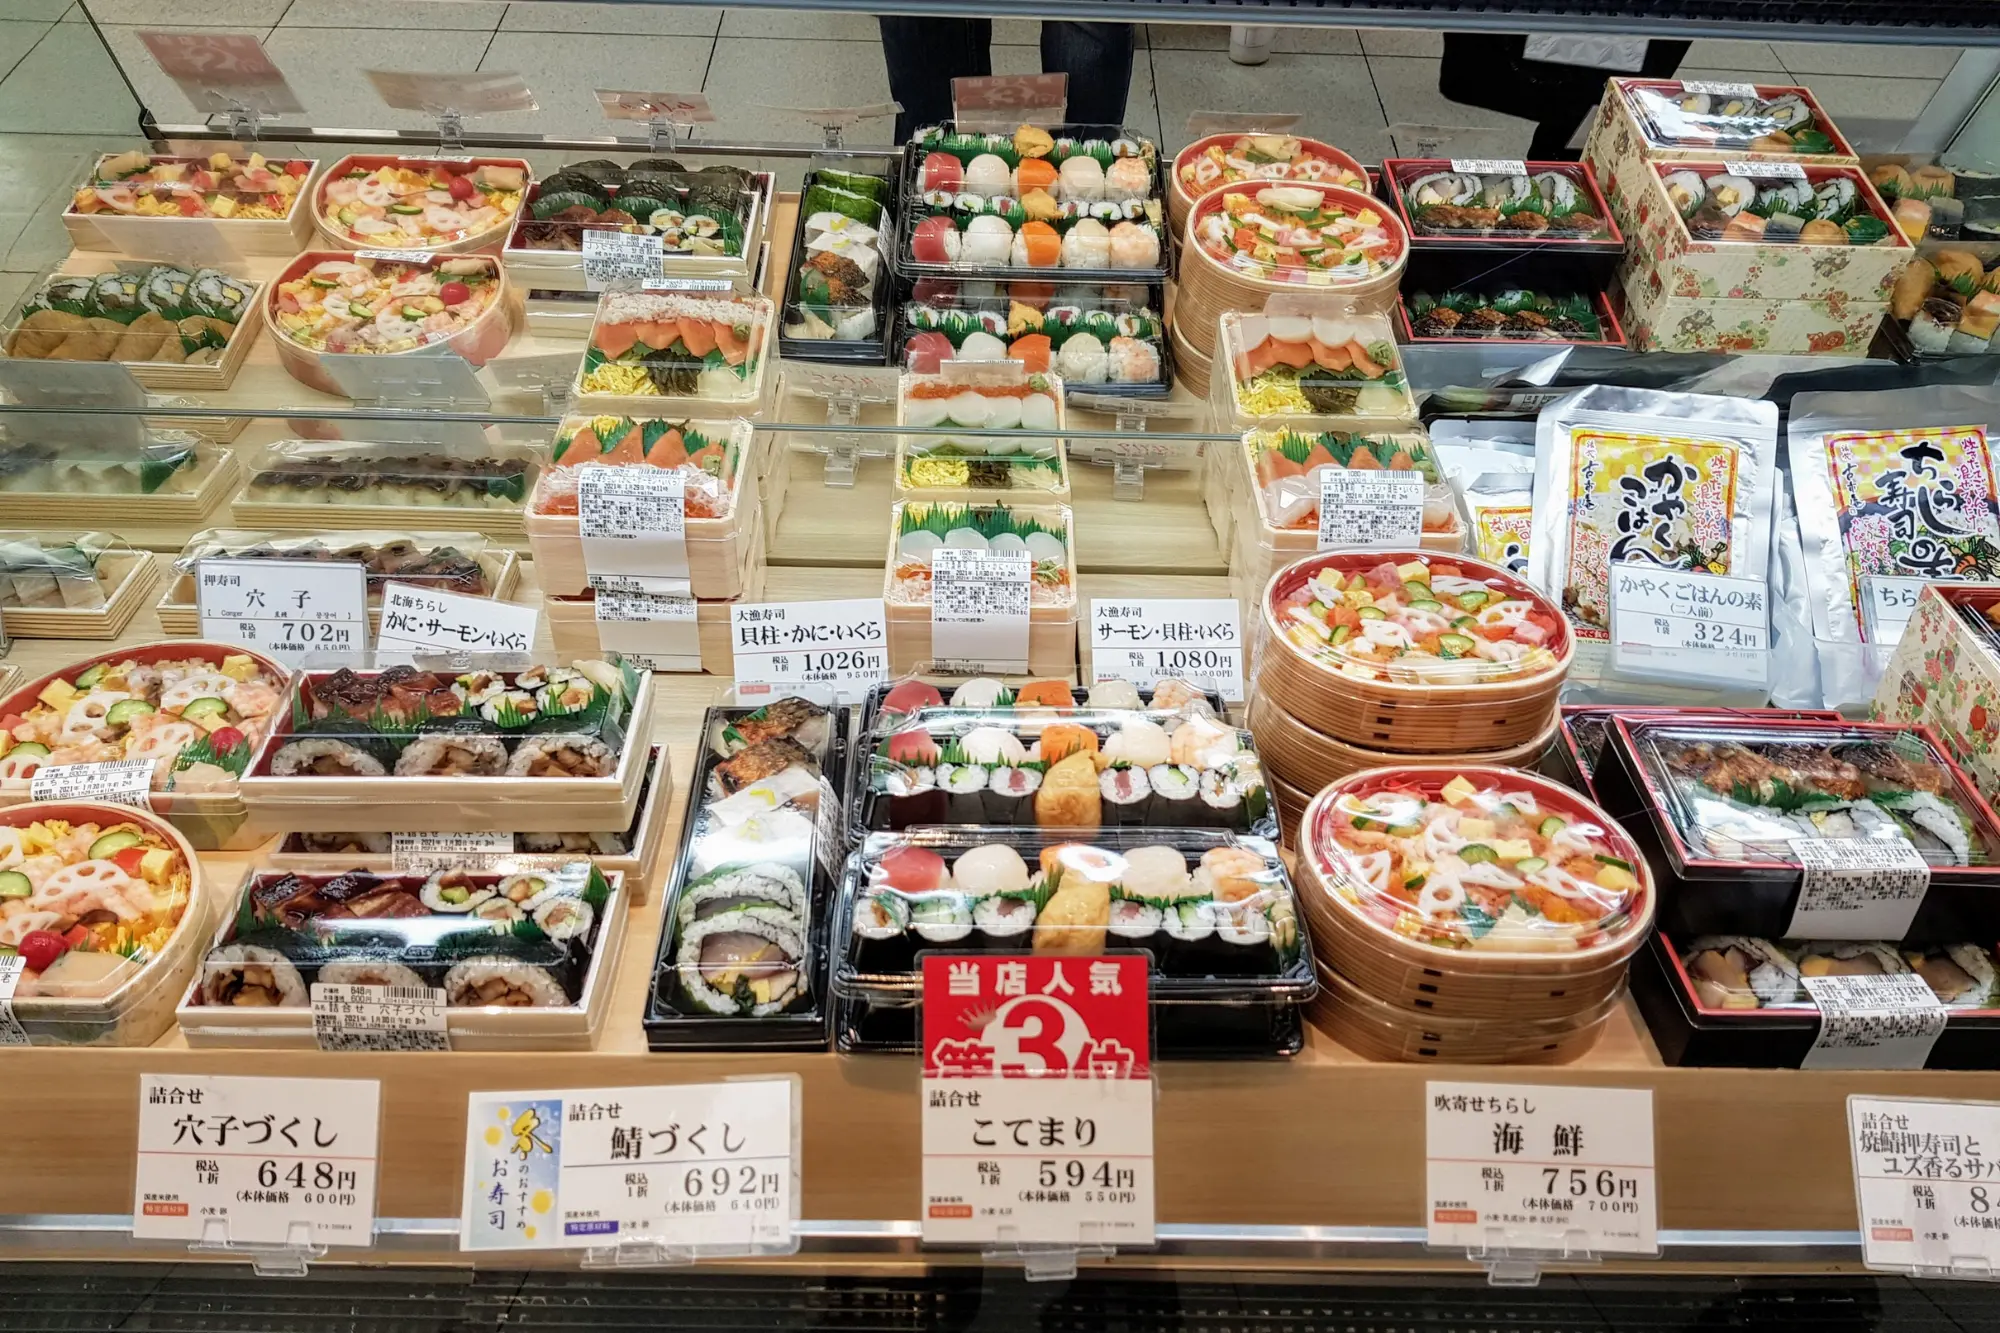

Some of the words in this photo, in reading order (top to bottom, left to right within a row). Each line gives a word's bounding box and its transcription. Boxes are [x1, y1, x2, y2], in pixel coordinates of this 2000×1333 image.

[1900, 441, 1975, 535] ちらし
[1644, 455, 1697, 549] かやく
[1609, 475, 1688, 570] ごはん
[204, 574, 240, 586] 押寿司
[246, 589, 311, 609] 穴子
[1619, 575, 1762, 611] かやくごはんの素
[391, 594, 448, 613] 北海ちらし
[1097, 606, 1142, 618] 大漁寿司
[1670, 603, 1713, 618] (二人前)
[736, 608, 785, 622] 大漁寿司
[240, 623, 256, 631] 税込
[282, 623, 349, 642] 702円
[386, 611, 527, 650] かに・サーモン・いくら
[740, 621, 881, 646] 貝柱・かに・いくら
[1098, 623, 1234, 641] サーモン・貝柱・いくら
[1654, 618, 1669, 626] 税込
[1695, 622, 1756, 647] 324円
[1656, 627, 1670, 635] 1袋
[773, 656, 788, 664] 税込
[804, 651, 880, 672] 1,026円
[775, 664, 789, 672] 1折
[802, 672, 837, 681] (本体価格
[948, 961, 1123, 996] 当店人気
[380, 1005, 440, 1017] 穴子づくし
[150, 1087, 204, 1104] 詰合せ
[929, 1090, 982, 1108] 詰合せ
[1434, 1095, 1537, 1114] 吹寄せちらし
[569, 1103, 623, 1121] 詰合せ
[1861, 1112, 1910, 1130] 詰合せ
[173, 1114, 338, 1148] 穴子づくし
[972, 1116, 1097, 1148] こてまり
[1493, 1122, 1584, 1156] 海鮮
[610, 1122, 746, 1160] 鯖づくし
[1860, 1130, 1981, 1157] 焼鯖押寿司と
[196, 1160, 219, 1172] 税込
[258, 1160, 356, 1190] 648円
[198, 1173, 219, 1184] 1折
[625, 1173, 649, 1185] 税込
[684, 1166, 780, 1197] 692円
[977, 1161, 1001, 1174] 税込
[1039, 1160, 1135, 1188] 594円
[979, 1173, 1001, 1185] 1折
[1482, 1167, 1504, 1179] 税込
[1542, 1168, 1637, 1198] 756円
[488, 1158, 510, 1231] お寿司
[627, 1186, 648, 1198] 1折
[1483, 1179, 1504, 1192] 1折
[236, 1190, 289, 1203] (本体価格
[304, 1193, 356, 1206] 600円)
[517, 1164, 529, 1230] のおすすめ
[1018, 1190, 1071, 1203] (本体価格
[1085, 1191, 1136, 1204] 550円)
[1522, 1198, 1574, 1211] (本体価格
[1588, 1200, 1639, 1214] 700円)
[1913, 1185, 1934, 1197] 税込
[1970, 1186, 2000, 1214] 8
[1916, 1198, 1935, 1210] 1折
[664, 1200, 717, 1214] (本体価格
